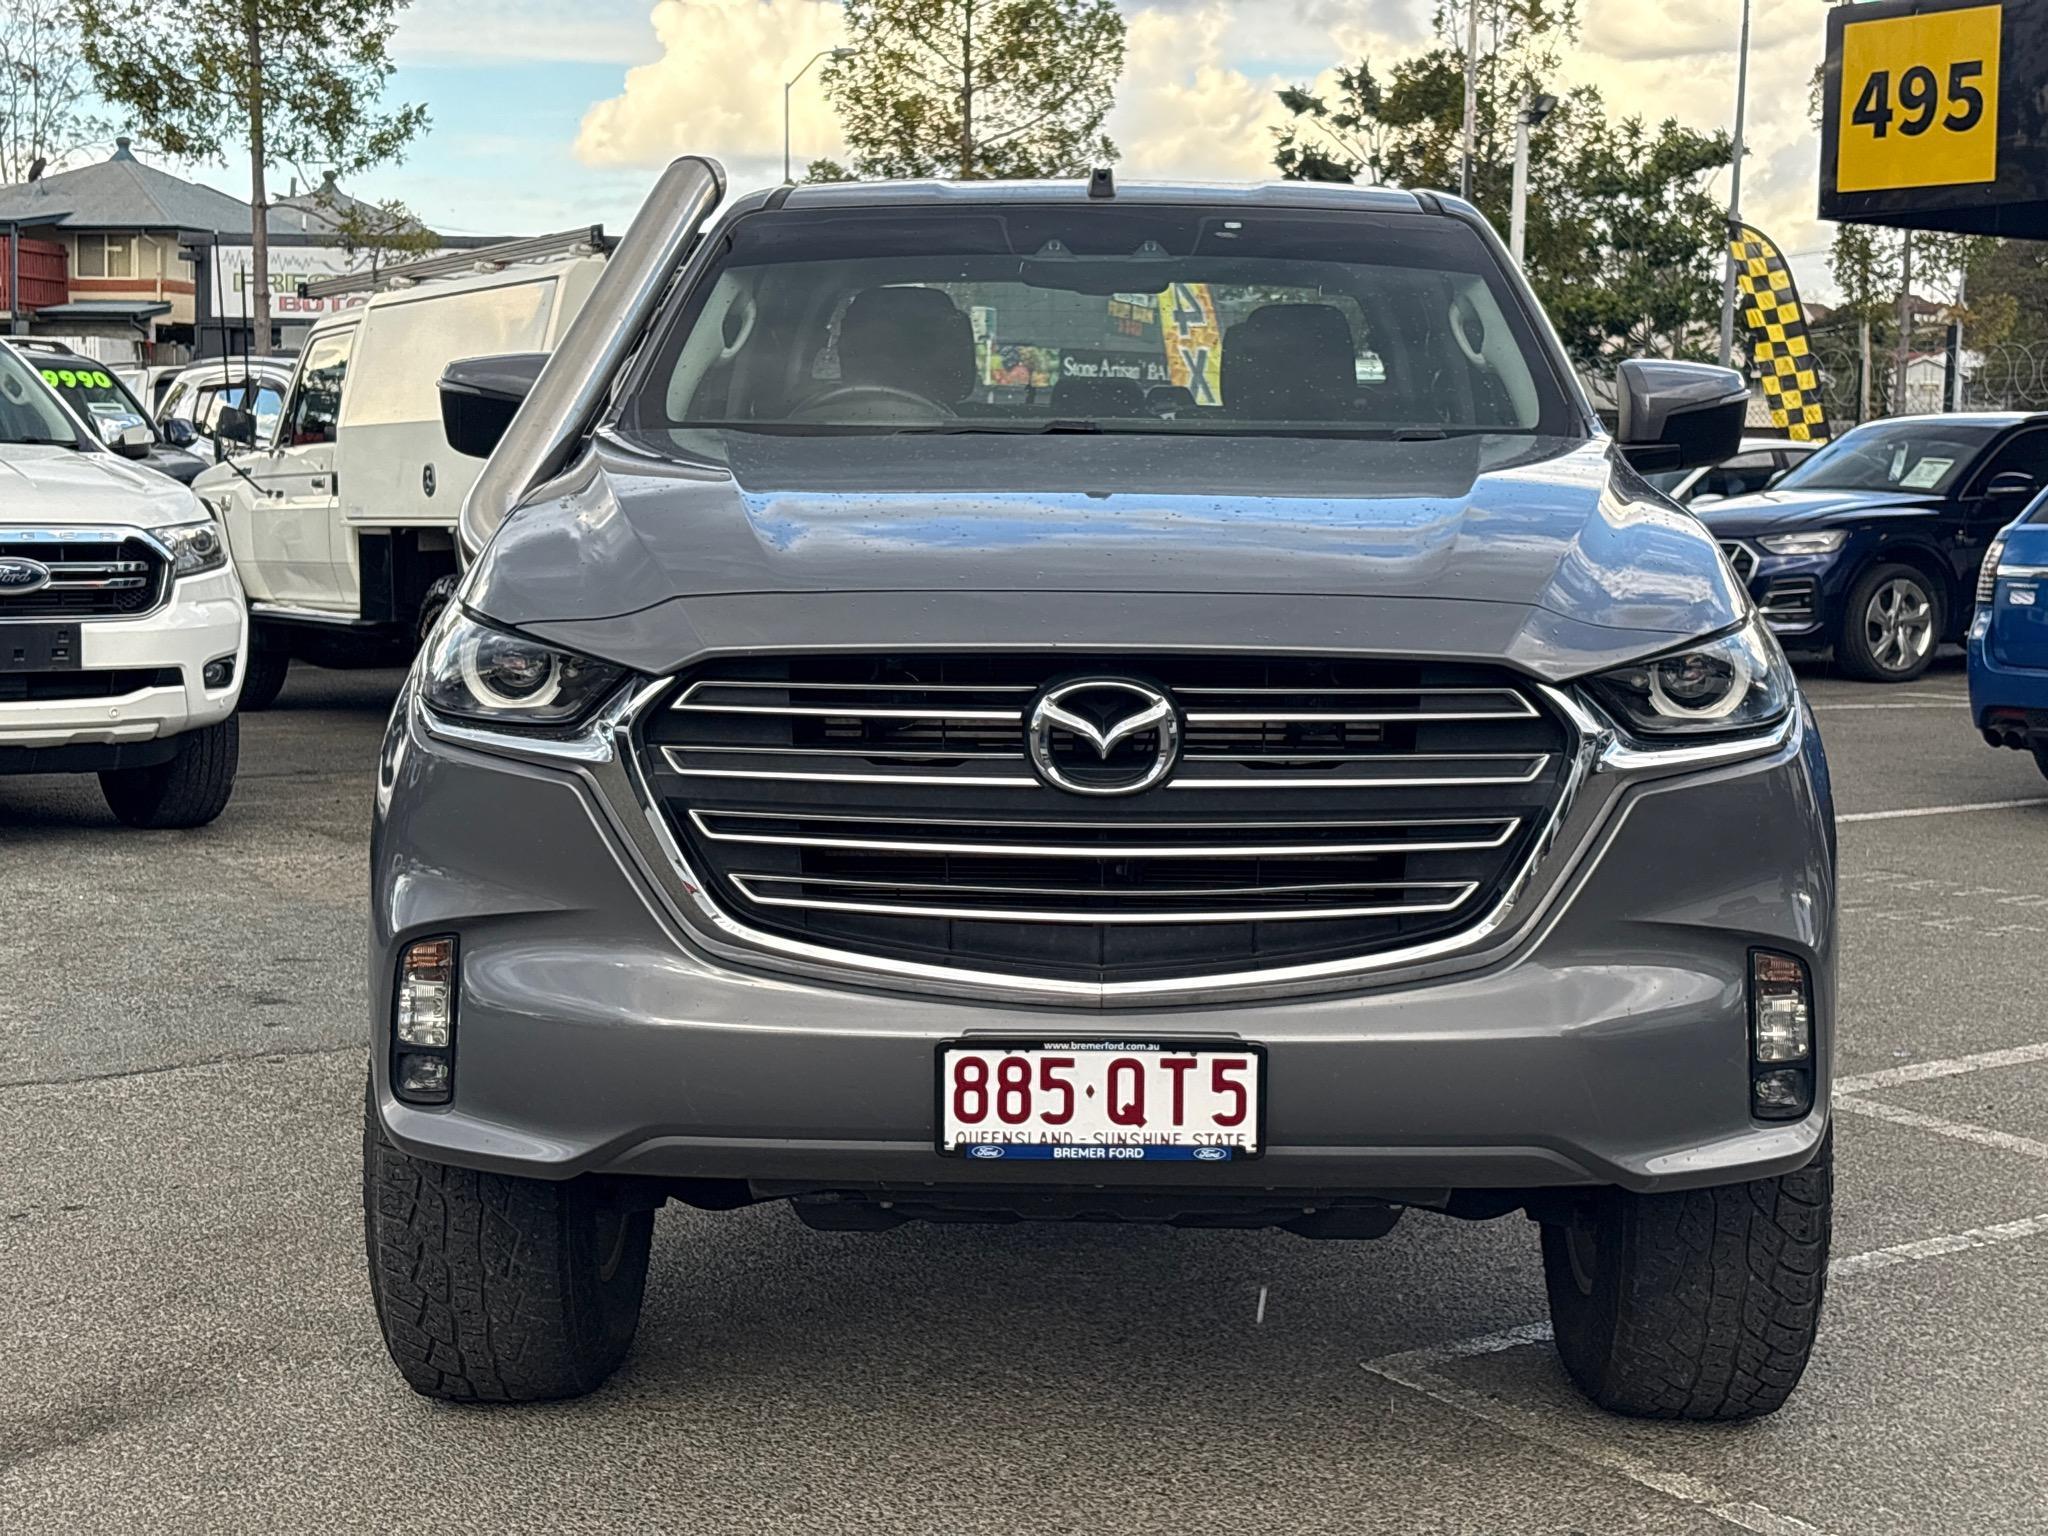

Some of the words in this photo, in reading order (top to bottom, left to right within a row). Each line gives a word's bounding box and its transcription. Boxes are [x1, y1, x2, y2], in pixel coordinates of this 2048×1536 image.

[1852, 60, 1984, 139] 495
[41, 370, 112, 388] 9990
[1043, 1042, 1160, 1051] www.bremerford.com.au
[956, 1131, 1073, 1145] QUEENSLAND
[1093, 1132, 1182, 1145] SUNSHINE
[1192, 1133, 1247, 1146] STATE
[1053, 1147, 1104, 1158] BREMER
[1109, 1147, 1145, 1159] FORD
